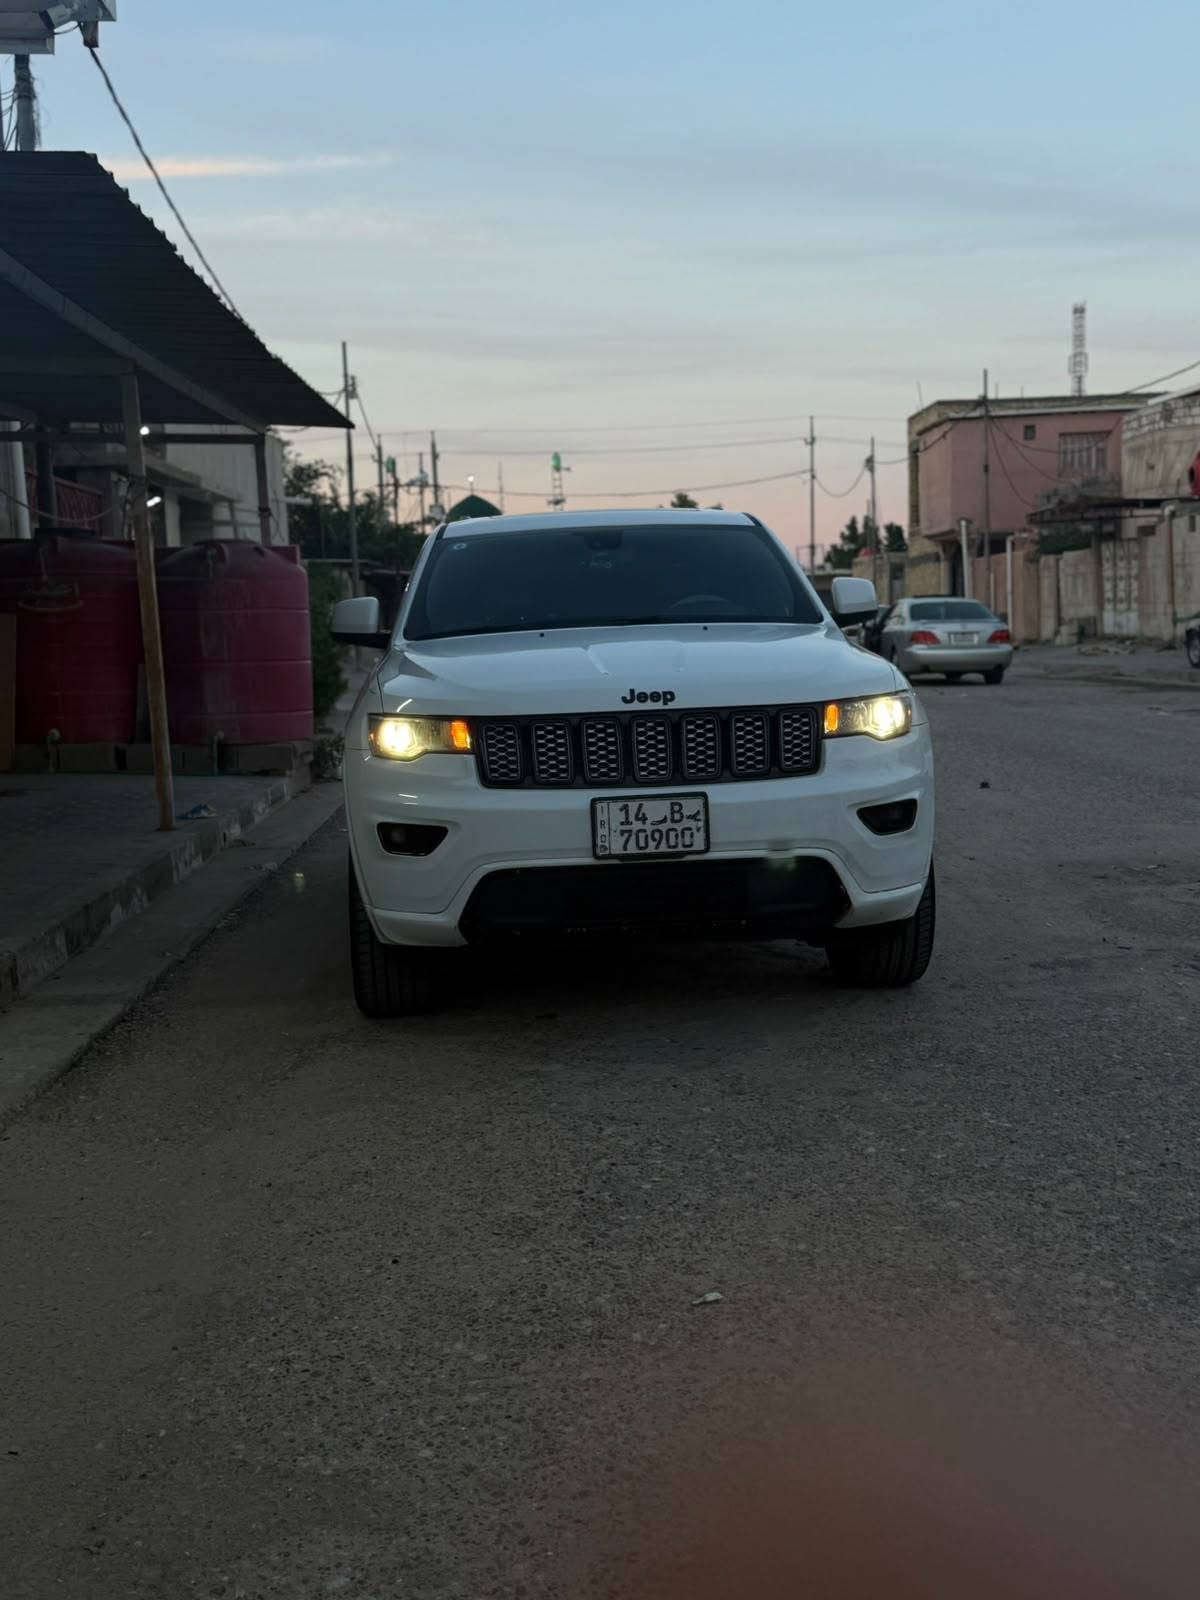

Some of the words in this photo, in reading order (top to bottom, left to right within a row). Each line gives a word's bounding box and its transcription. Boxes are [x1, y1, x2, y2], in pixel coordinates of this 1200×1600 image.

[621, 688, 676, 706] Jeep
[619, 803, 649, 826] 14
[619, 827, 695, 851] 70900
